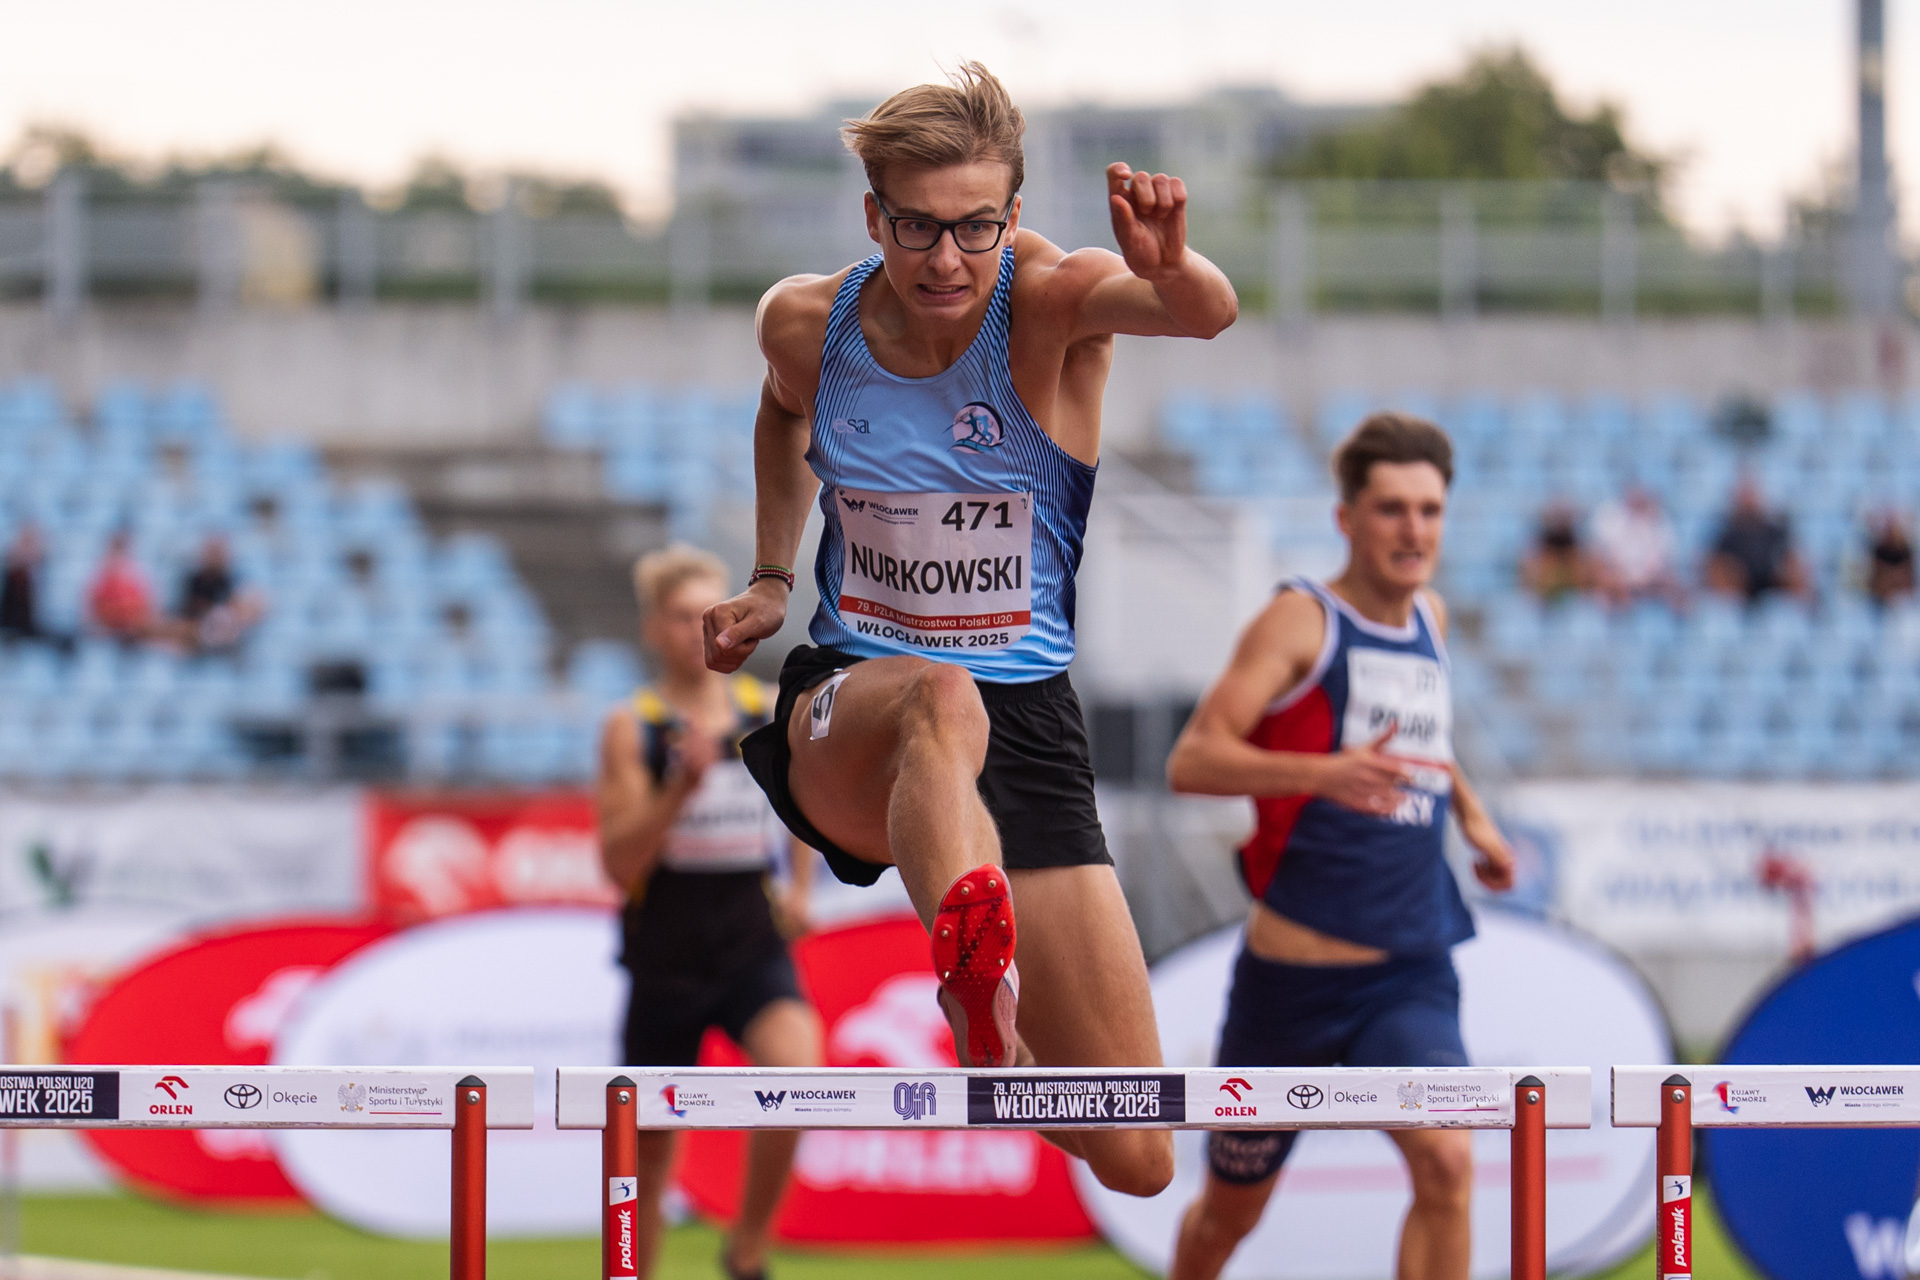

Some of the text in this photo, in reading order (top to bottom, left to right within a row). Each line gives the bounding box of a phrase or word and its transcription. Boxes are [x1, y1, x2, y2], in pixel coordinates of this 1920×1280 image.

[868, 501, 919, 516] WŁOCŁAWEK
[941, 501, 1013, 531] 471
[851, 541, 1022, 595] NURKOWSKI
[857, 600, 1013, 628] 79. PZLA Mistrzostwa Polski U20
[857, 620, 1009, 648] WŁOCŁAWEK 2025
[812, 684, 834, 720] 5
[36, 1076, 72, 1090] POLSKI
[74, 1076, 94, 1089] U20
[993, 1080, 1161, 1096] 79. PZLA MISTRZOSTWA POLSKI U20
[1427, 1083, 1482, 1092] Ministerstwo
[1840, 1086, 1904, 1095] WŁOCŁAWEK
[0, 1089, 93, 1114] WEK 2025
[272, 1091, 318, 1106] Okęcie
[368, 1096, 398, 1107] Sportu
[404, 1096, 444, 1107] Turystyki
[790, 1090, 856, 1100] WŁOCŁAWEK
[1334, 1091, 1378, 1105] Okęcie
[1427, 1094, 1455, 1104] Sportu
[1462, 1094, 1500, 1104] Turystyki
[149, 1104, 193, 1115] ORLEN
[993, 1093, 1160, 1119] WŁOCŁAWEK 2025
[1214, 1106, 1257, 1117] ORLEN
[618, 1209, 634, 1270] polanik
[1671, 1206, 1688, 1268] polanik
